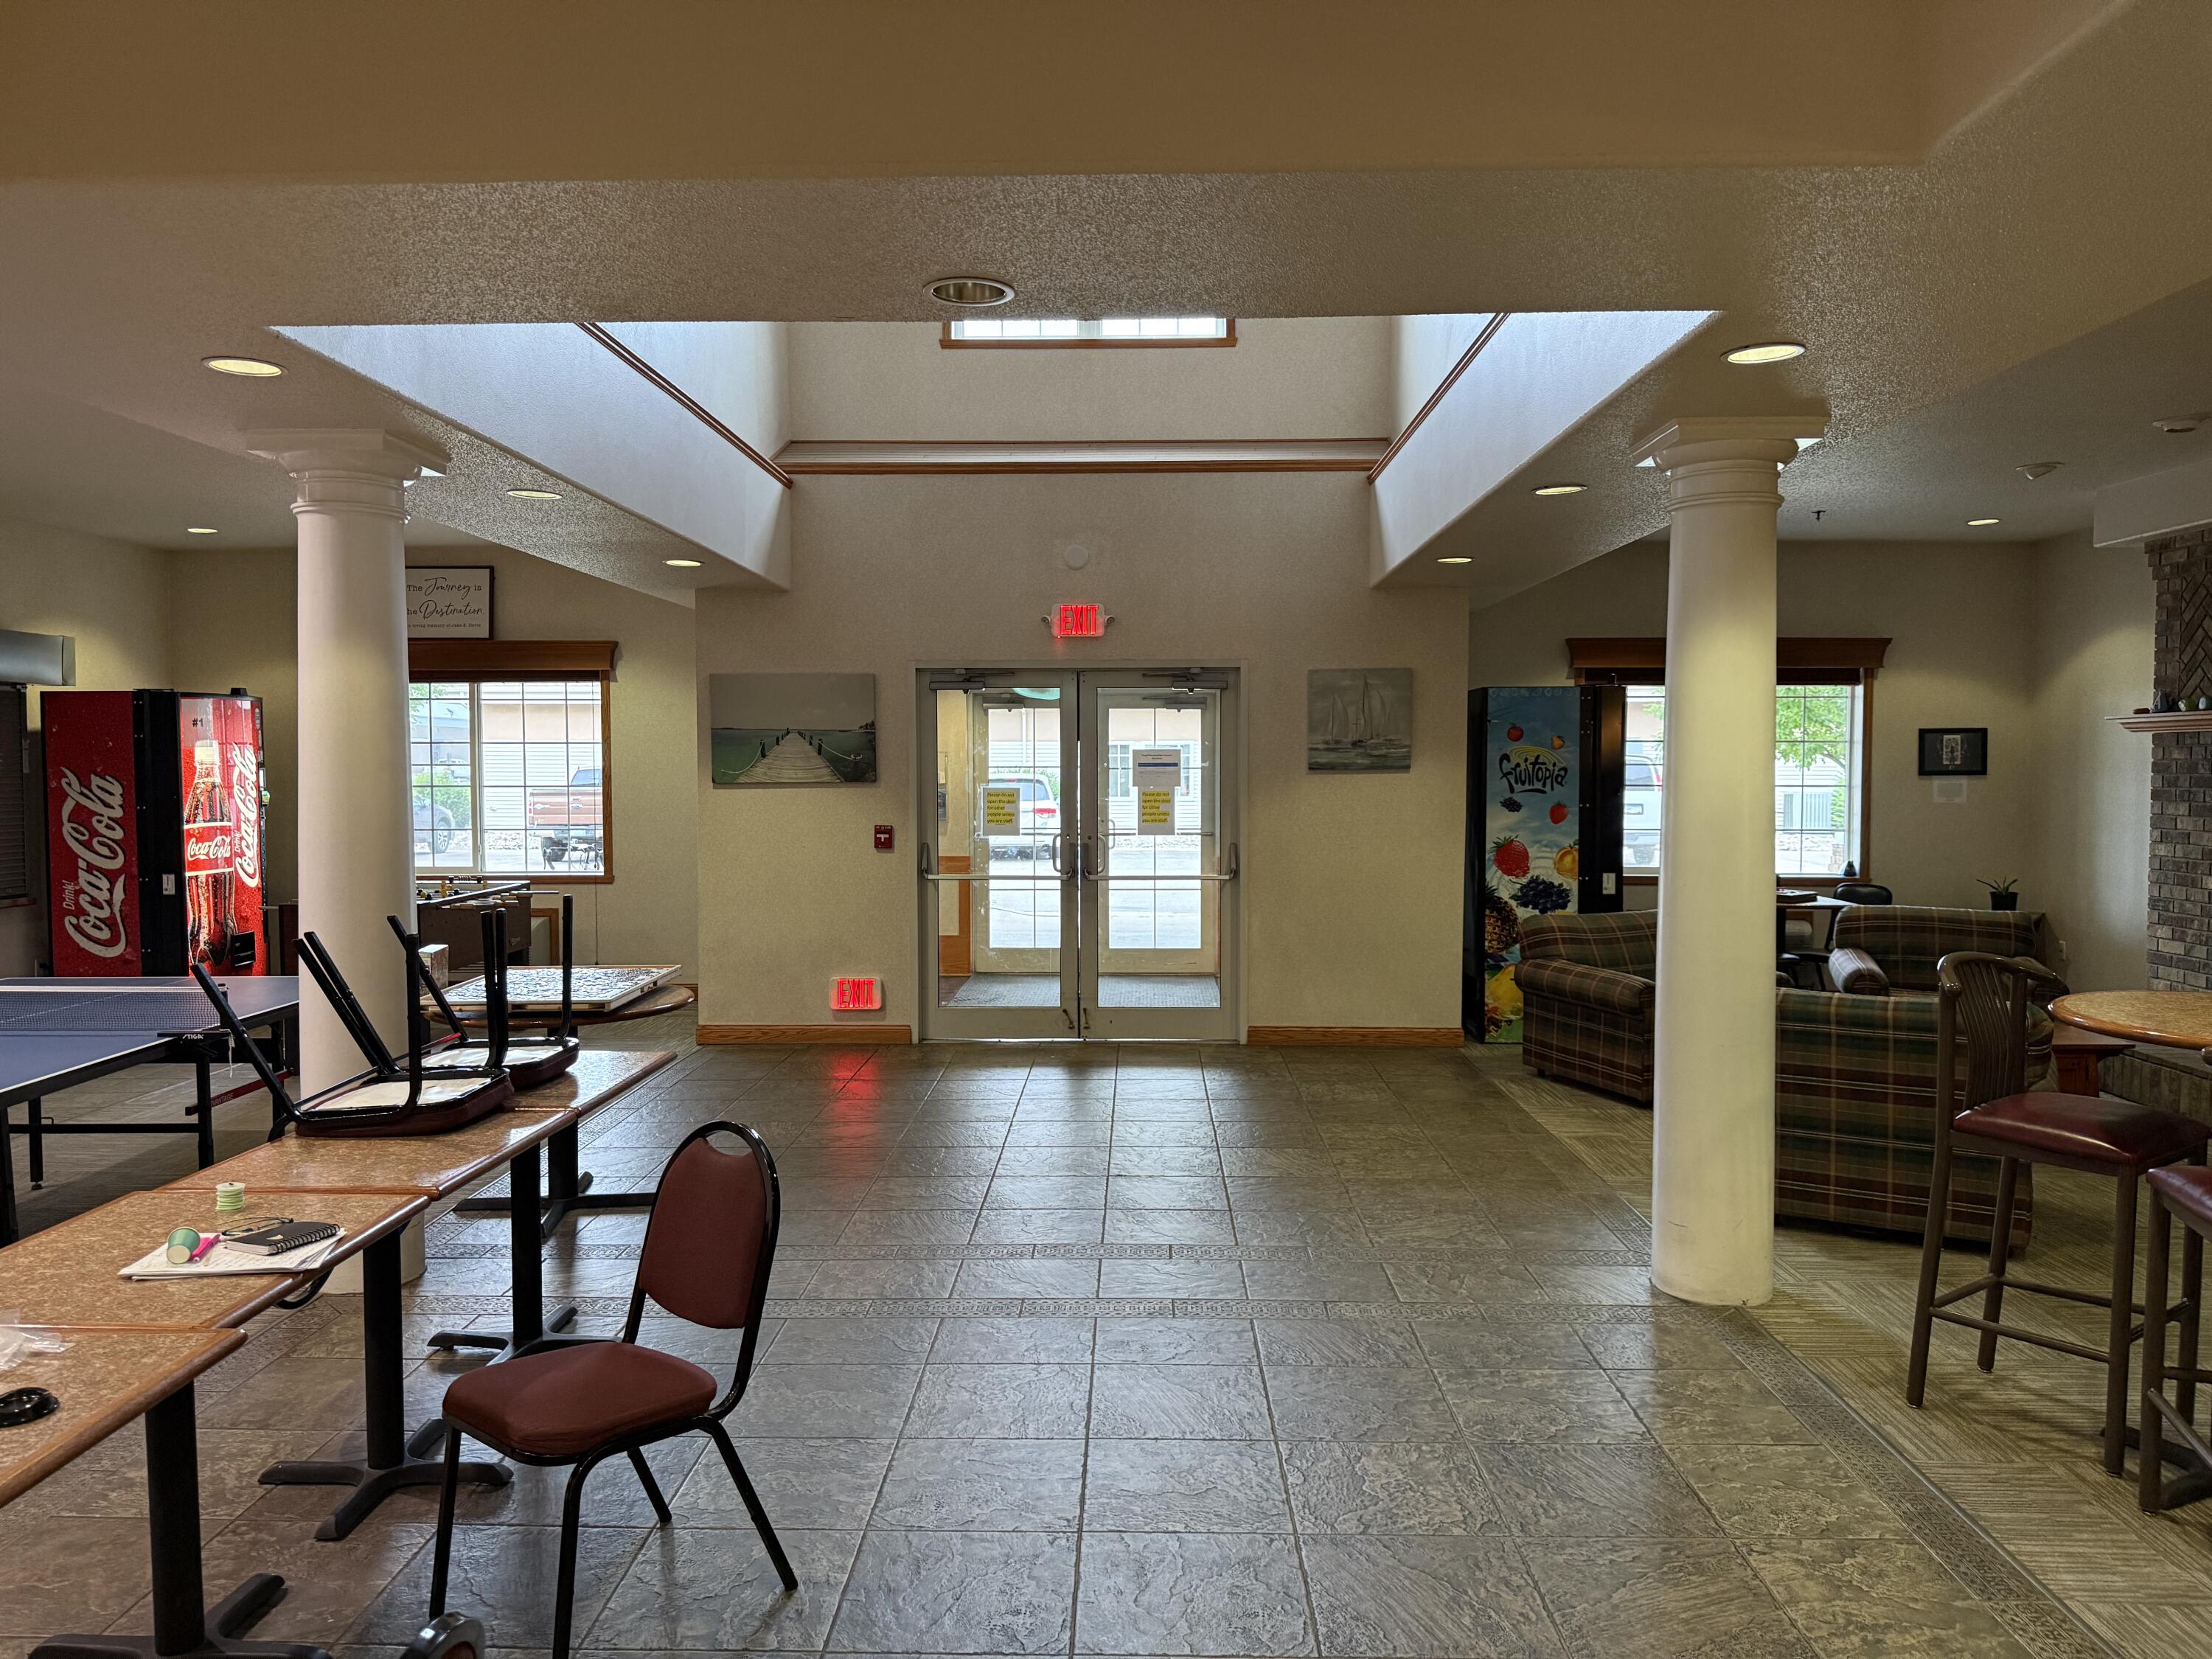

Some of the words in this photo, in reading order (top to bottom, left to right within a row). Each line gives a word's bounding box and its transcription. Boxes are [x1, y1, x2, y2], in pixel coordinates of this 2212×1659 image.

[425, 577, 470, 600] Journey
[1060, 605, 1099, 635] EXIT
[192, 717, 204, 728] #1
[232, 742, 259, 888] Coca-Cola
[187, 835, 231, 861] Coca-Cola
[234, 830, 243, 852] Drink!
[60, 767, 126, 958] Coca-Cola
[62, 880, 75, 910] Drink!
[837, 978, 875, 1008] EXIT
